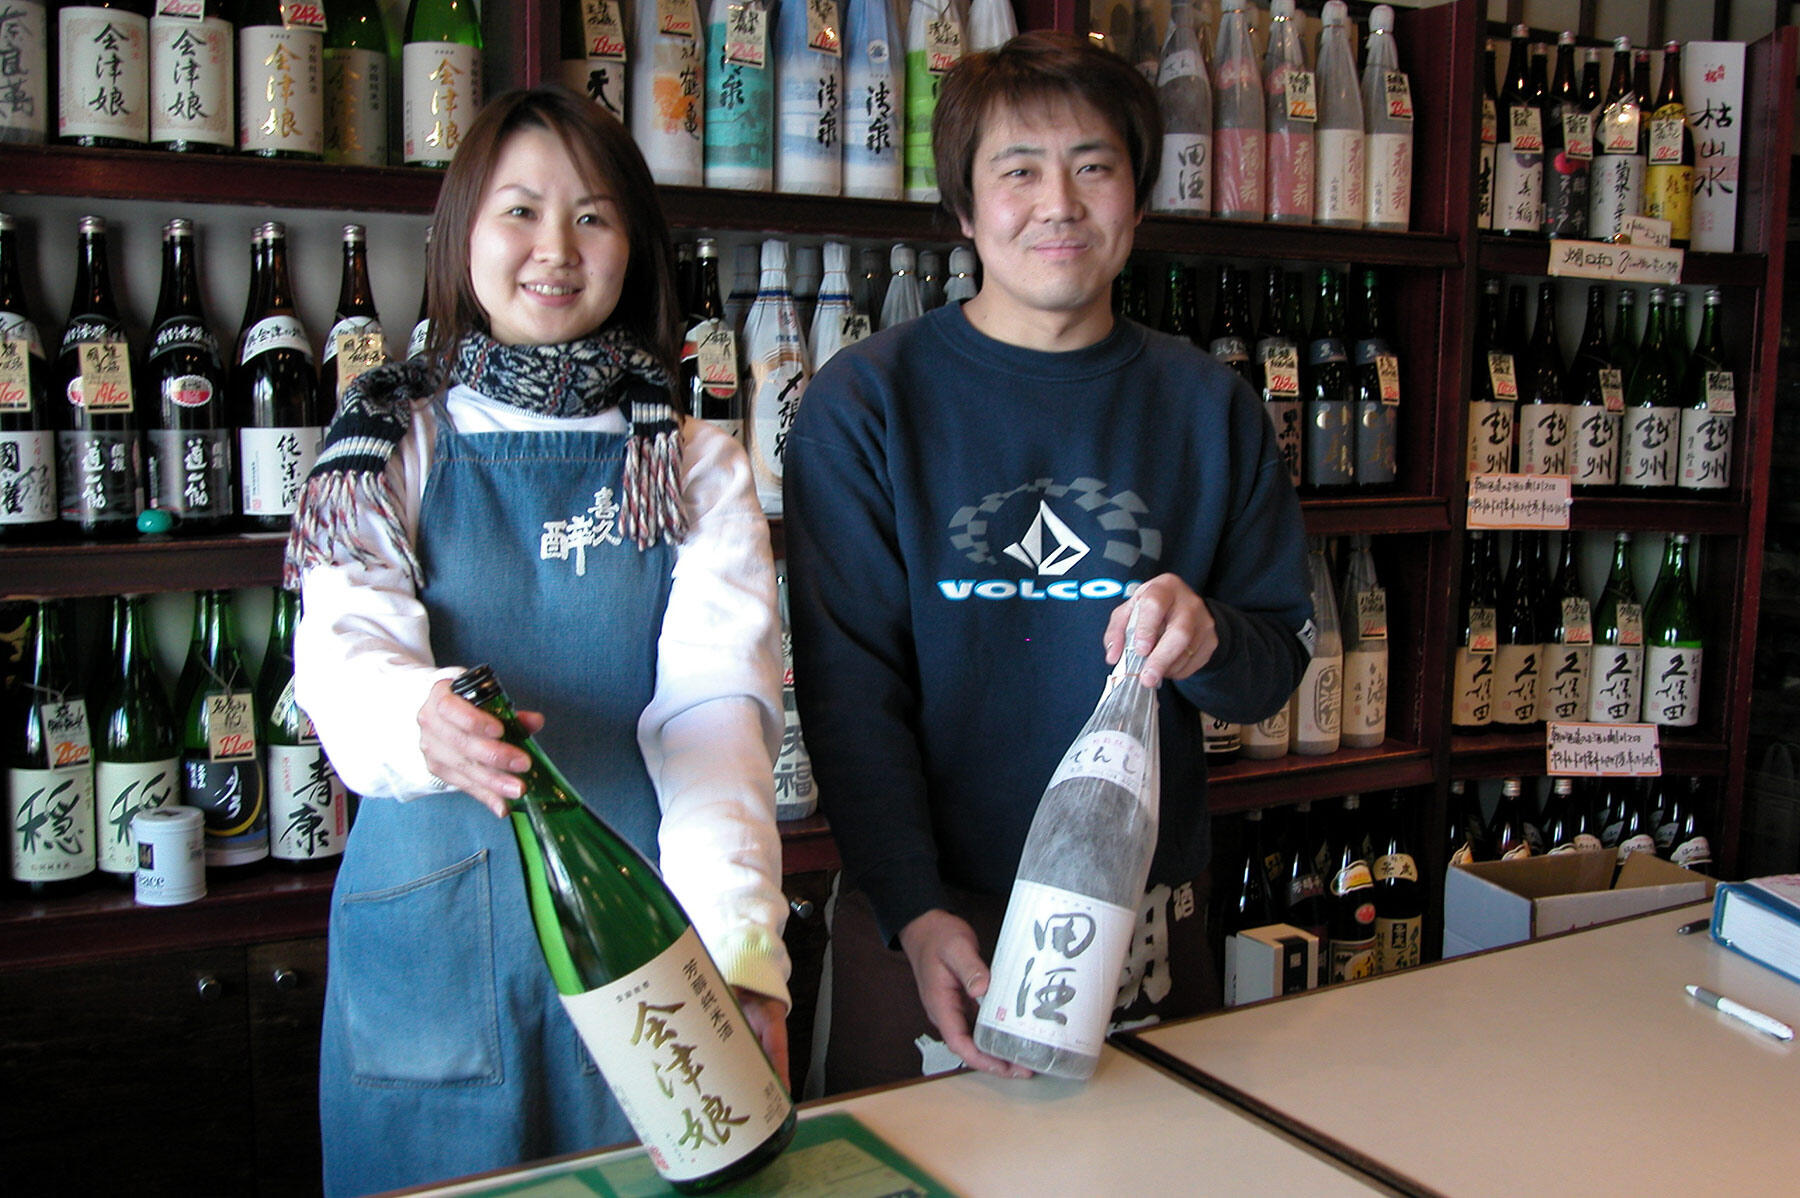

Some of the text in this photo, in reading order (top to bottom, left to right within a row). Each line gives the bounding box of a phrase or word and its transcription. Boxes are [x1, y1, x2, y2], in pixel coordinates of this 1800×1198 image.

[89, 23, 130, 117] 会津娘
[168, 28, 208, 121] 会津娘
[260, 43, 302, 138] 会津娘
[425, 58, 466, 150] 会津娘
[818, 75, 838, 148] 清泉
[866, 80, 892, 154] 清泉
[1690, 98, 1734, 198] 枯山水
[1581, 410, 1613, 479] 越州
[1635, 413, 1672, 481] 越州
[1695, 416, 1729, 482] 越州
[1465, 653, 1493, 721] 久保田
[1507, 653, 1538, 720] 久保田
[1549, 652, 1581, 719] 久保田
[1600, 653, 1632, 720] 久保田
[1655, 653, 1688, 721] 久保田
[17, 779, 83, 856] 穏
[1015, 912, 1097, 1027] 田酒
[630, 1000, 751, 1150] 会津娘
